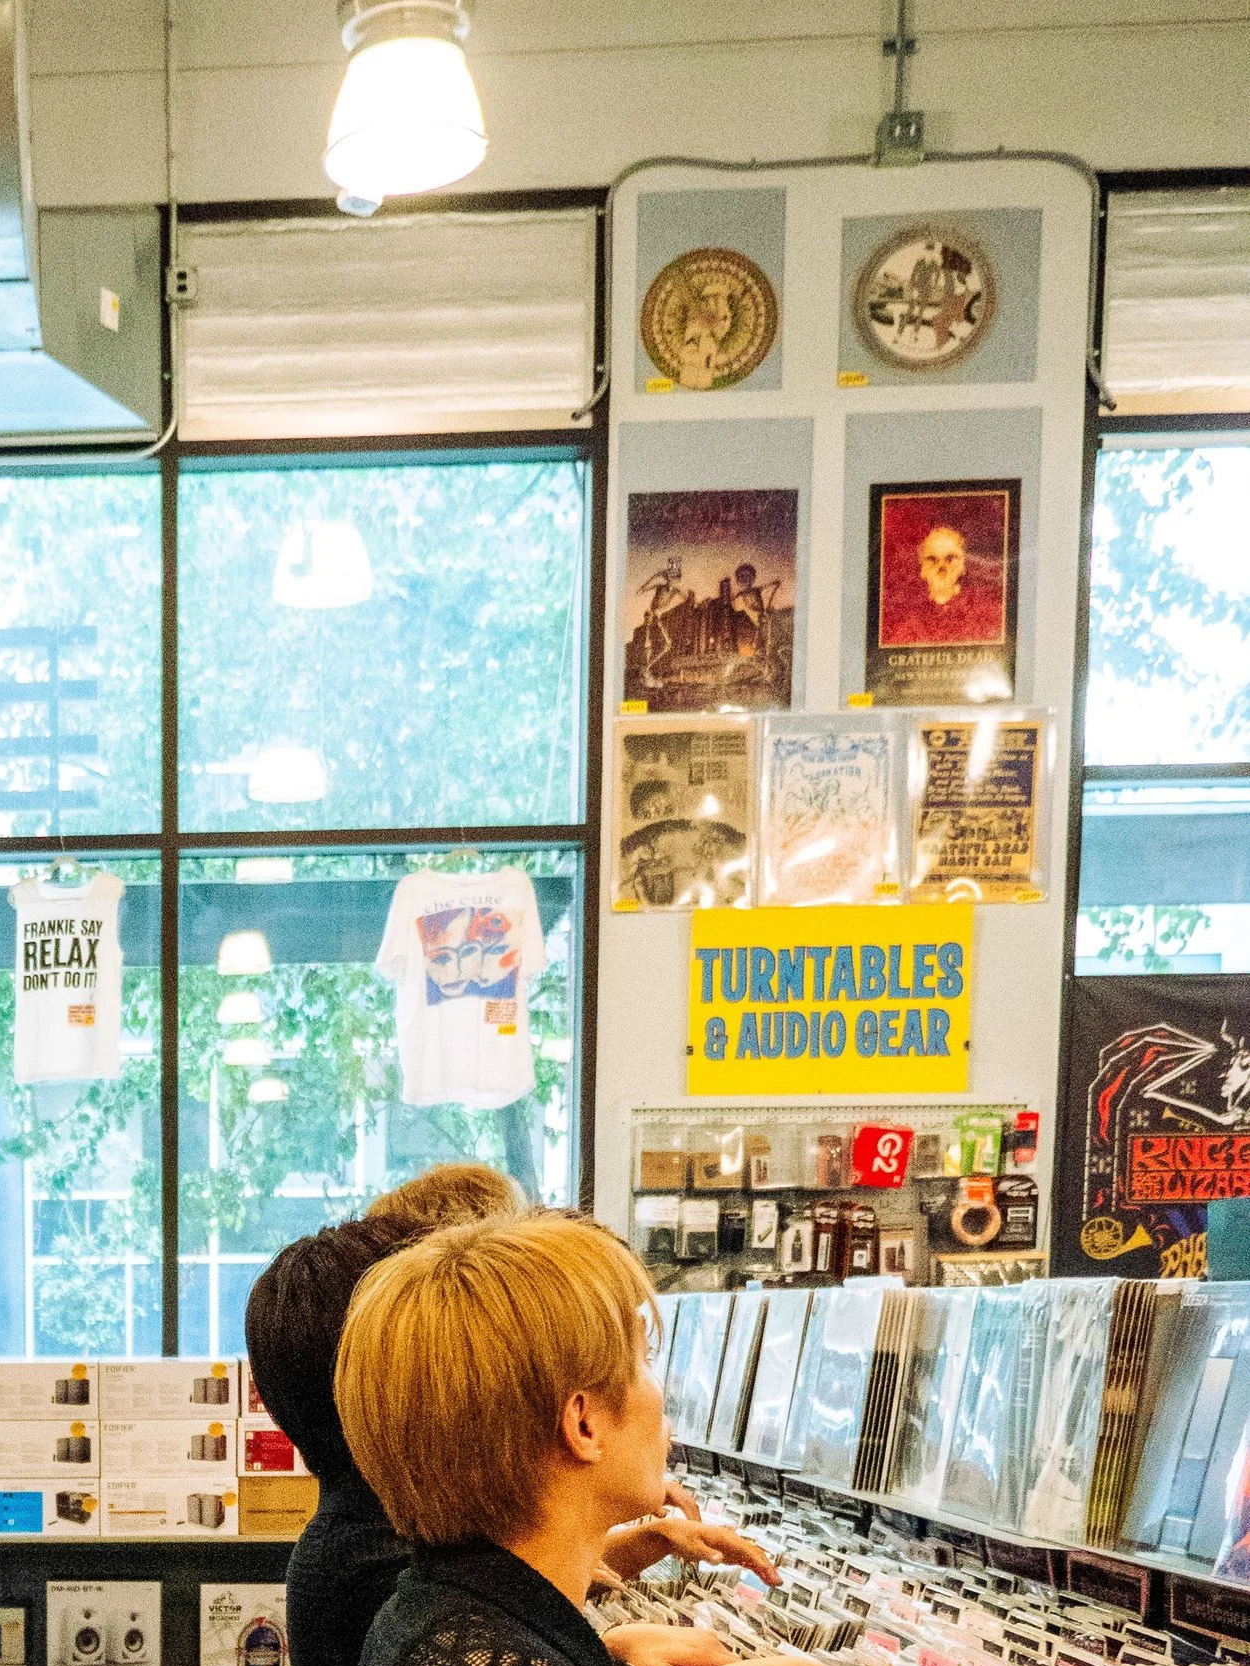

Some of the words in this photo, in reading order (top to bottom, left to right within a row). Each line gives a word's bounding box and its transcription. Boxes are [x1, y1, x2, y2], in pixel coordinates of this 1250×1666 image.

[23, 919, 76, 939] FRANKIE
[80, 919, 103, 936] SAY
[23, 937, 99, 973] RELAX
[23, 972, 60, 991] DON'T
[64, 972, 81, 988] DO
[695, 942, 963, 1003] TURNTABLES
[704, 1017, 728, 1061] &
[736, 1010, 847, 1060] AUDIO
[855, 1008, 950, 1057] GEAR
[106, 1365, 135, 1373] EDIFIER
[104, 1424, 134, 1432] EDIFIER
[107, 1482, 136, 1490] EDIFIER
[209, 1604, 241, 1613] VICTOR
